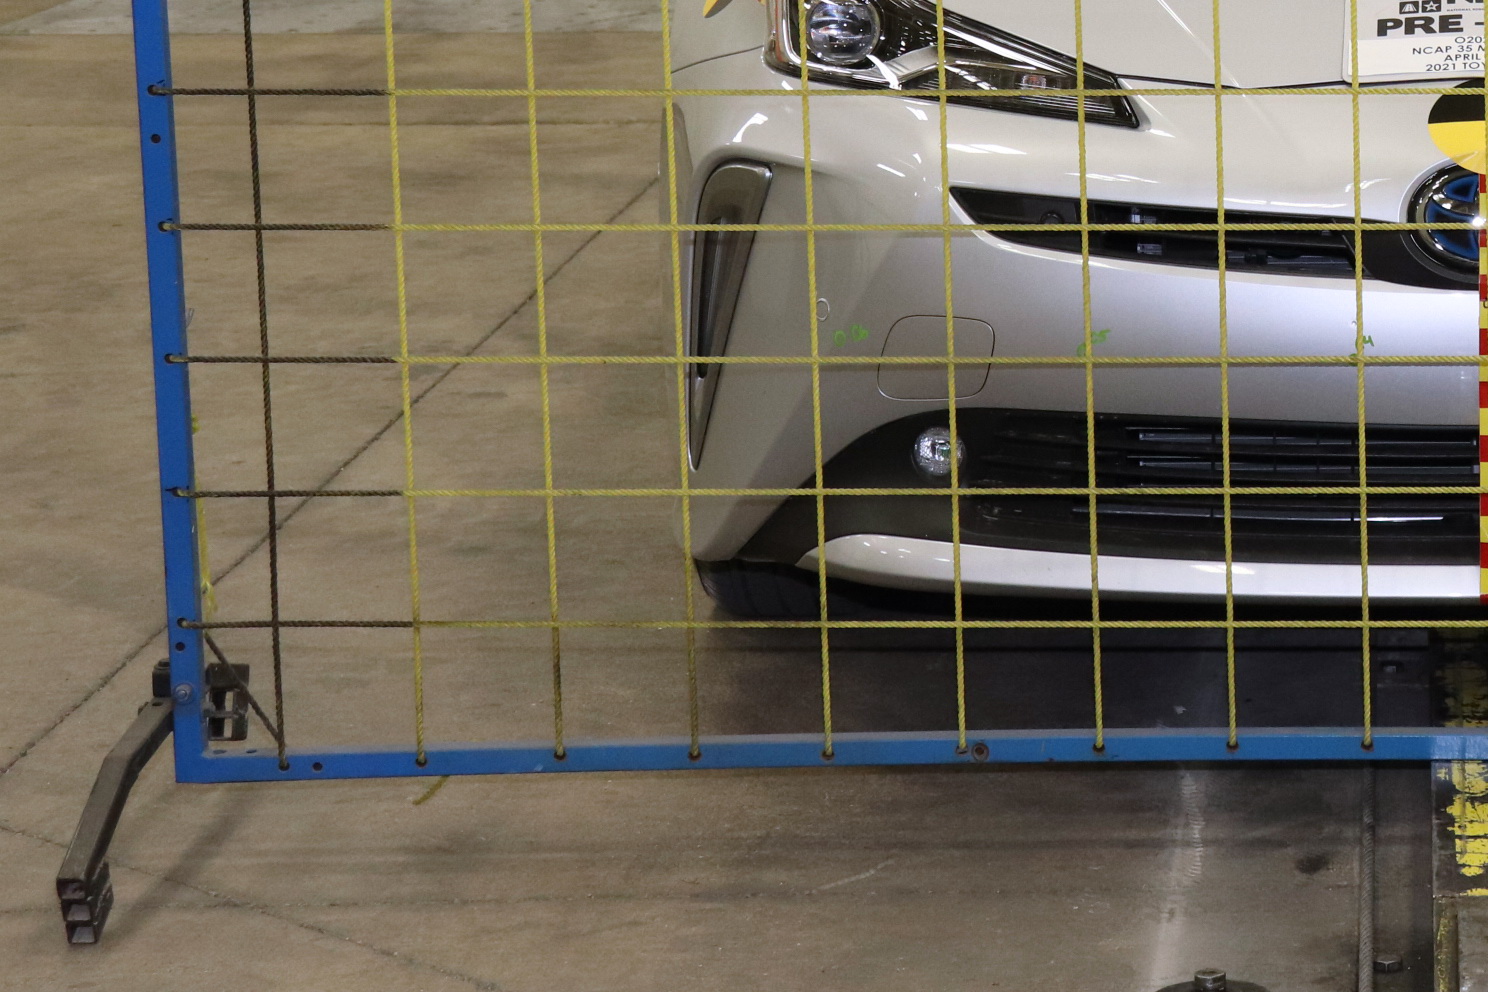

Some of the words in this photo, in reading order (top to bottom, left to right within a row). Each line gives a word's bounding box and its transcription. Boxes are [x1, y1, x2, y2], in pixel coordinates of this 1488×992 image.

[1376, 14, 1465, 37] PRE
[1412, 45, 1453, 55] NCAP
[1457, 44, 1473, 53] 35
[1444, 54, 1482, 62] APRIL
[1425, 63, 1457, 72] 2021
